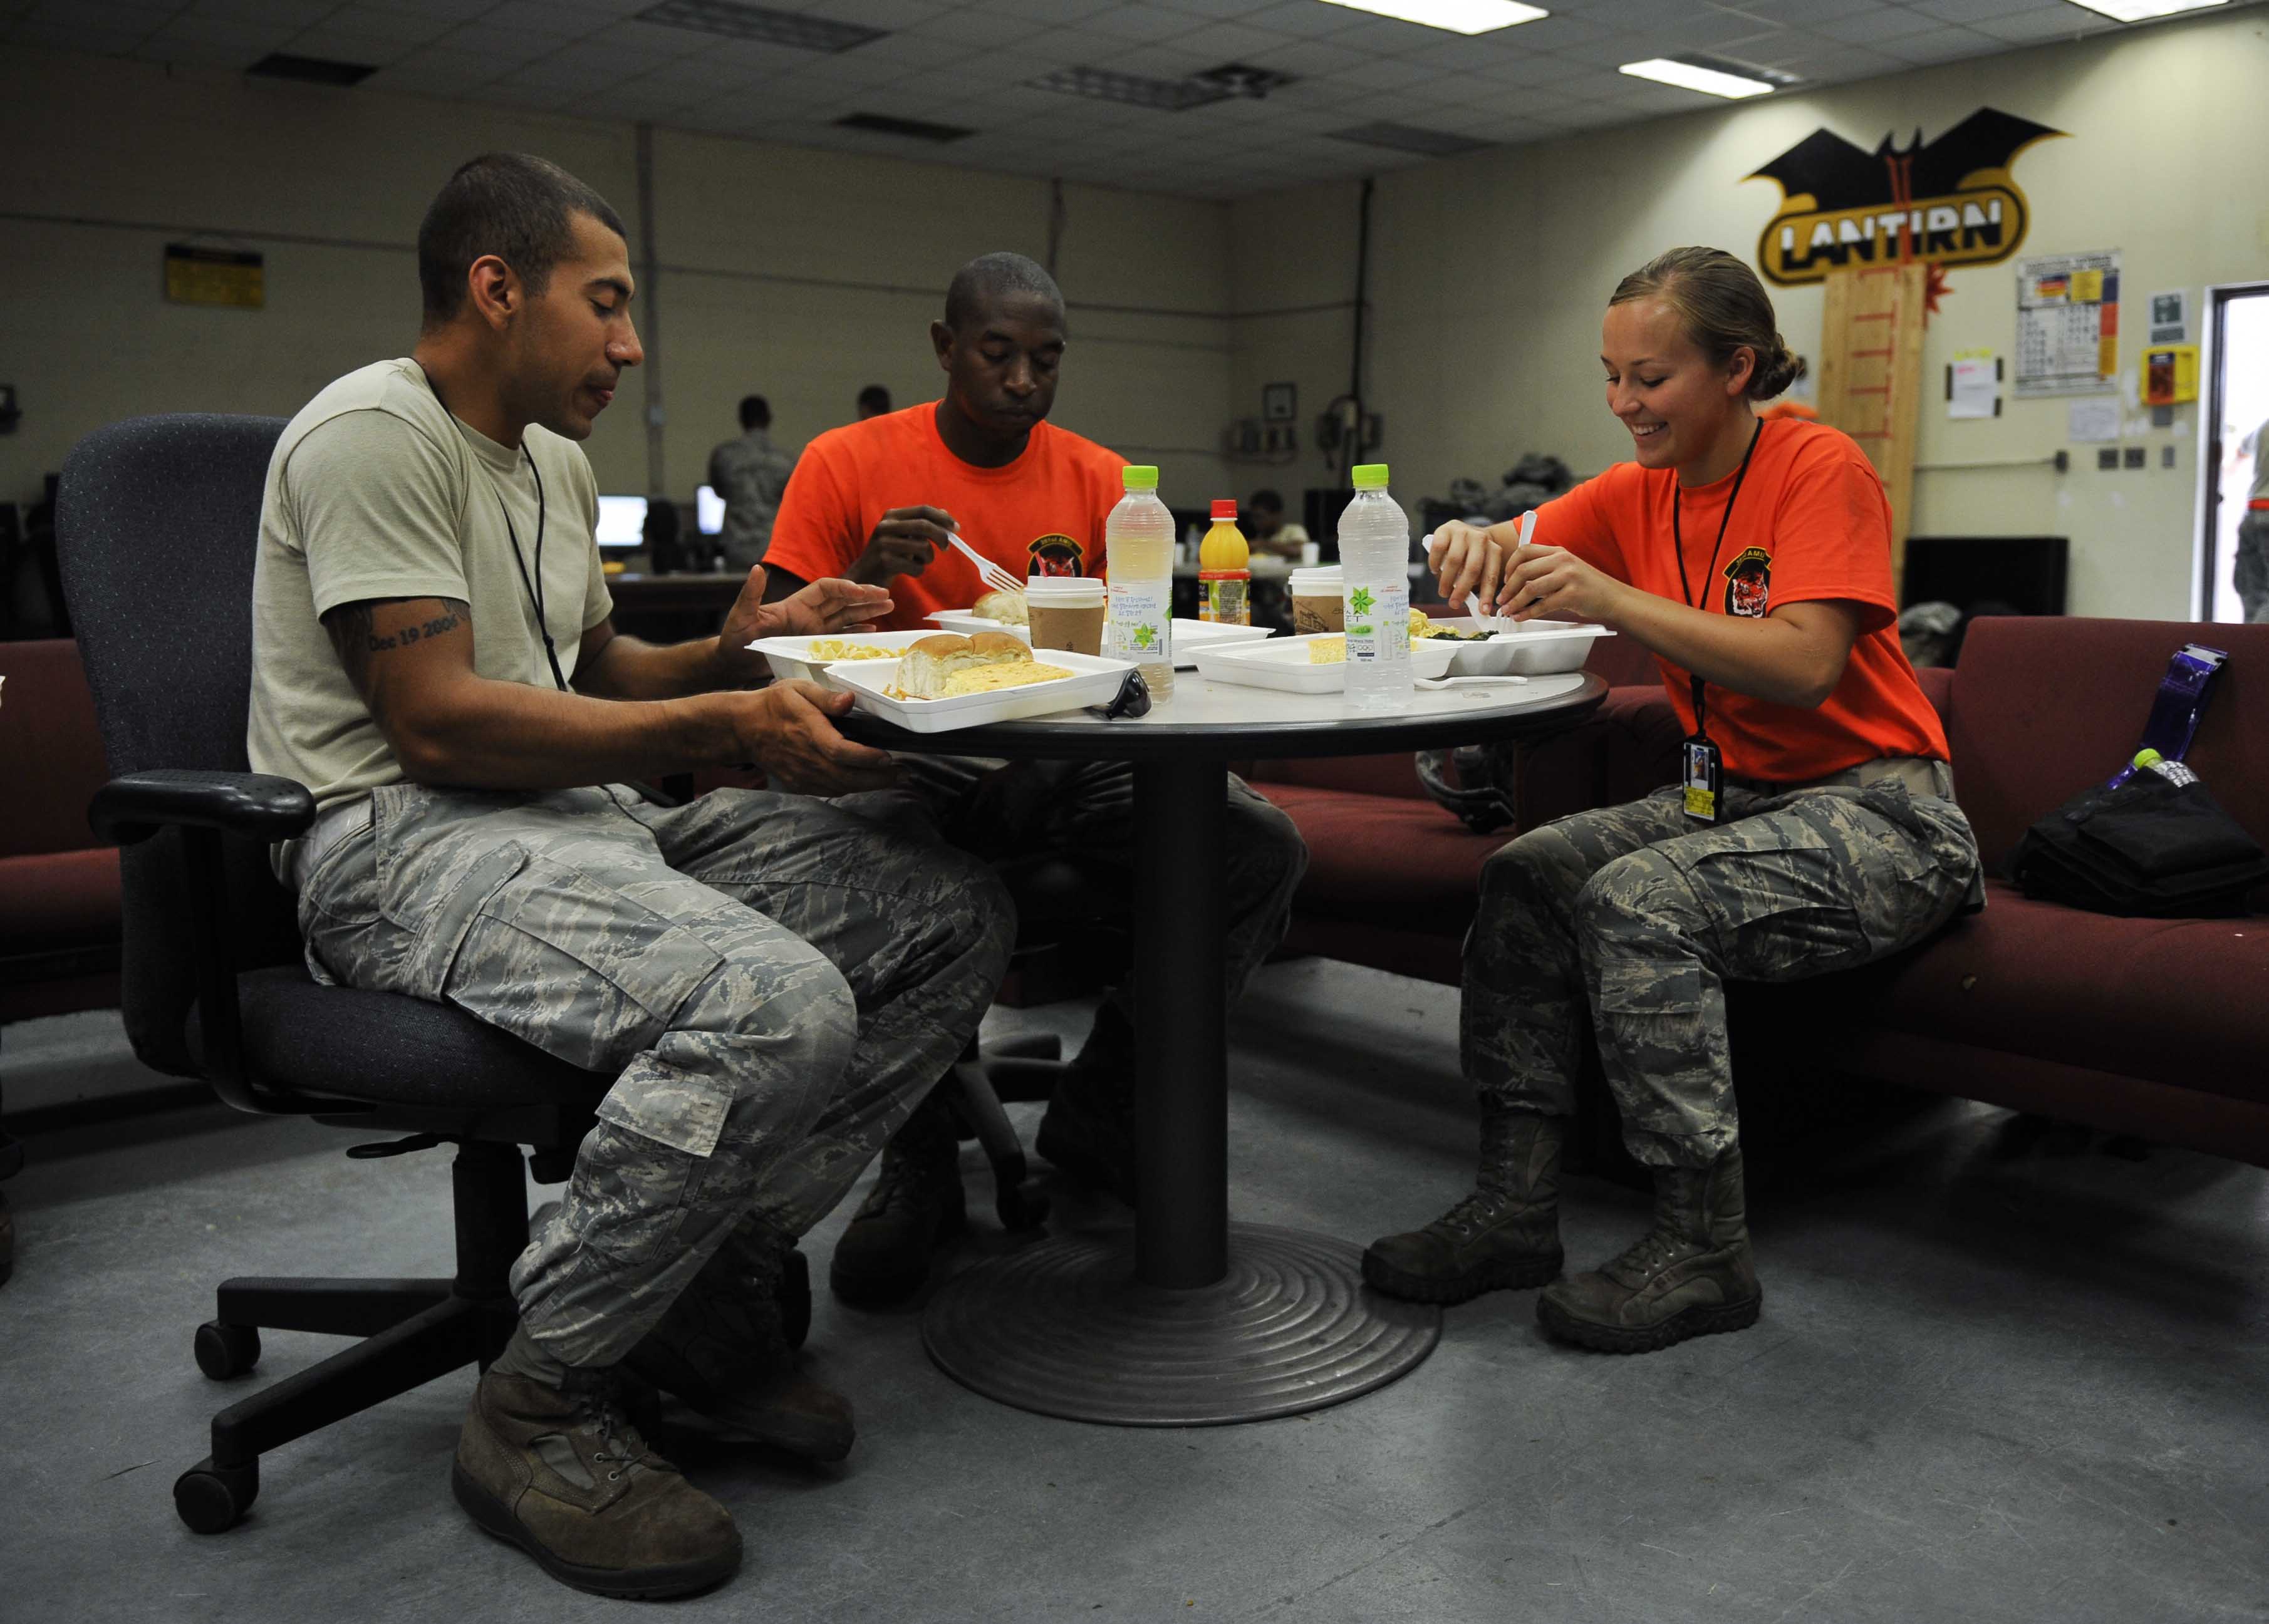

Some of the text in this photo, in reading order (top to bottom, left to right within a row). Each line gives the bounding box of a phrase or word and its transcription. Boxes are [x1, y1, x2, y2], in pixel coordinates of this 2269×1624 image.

[1781, 199, 2002, 271] LANTIRN
[1748, 550, 1765, 558] AMU
[369, 634, 396, 651] Dec
[400, 627, 419, 645] 19
